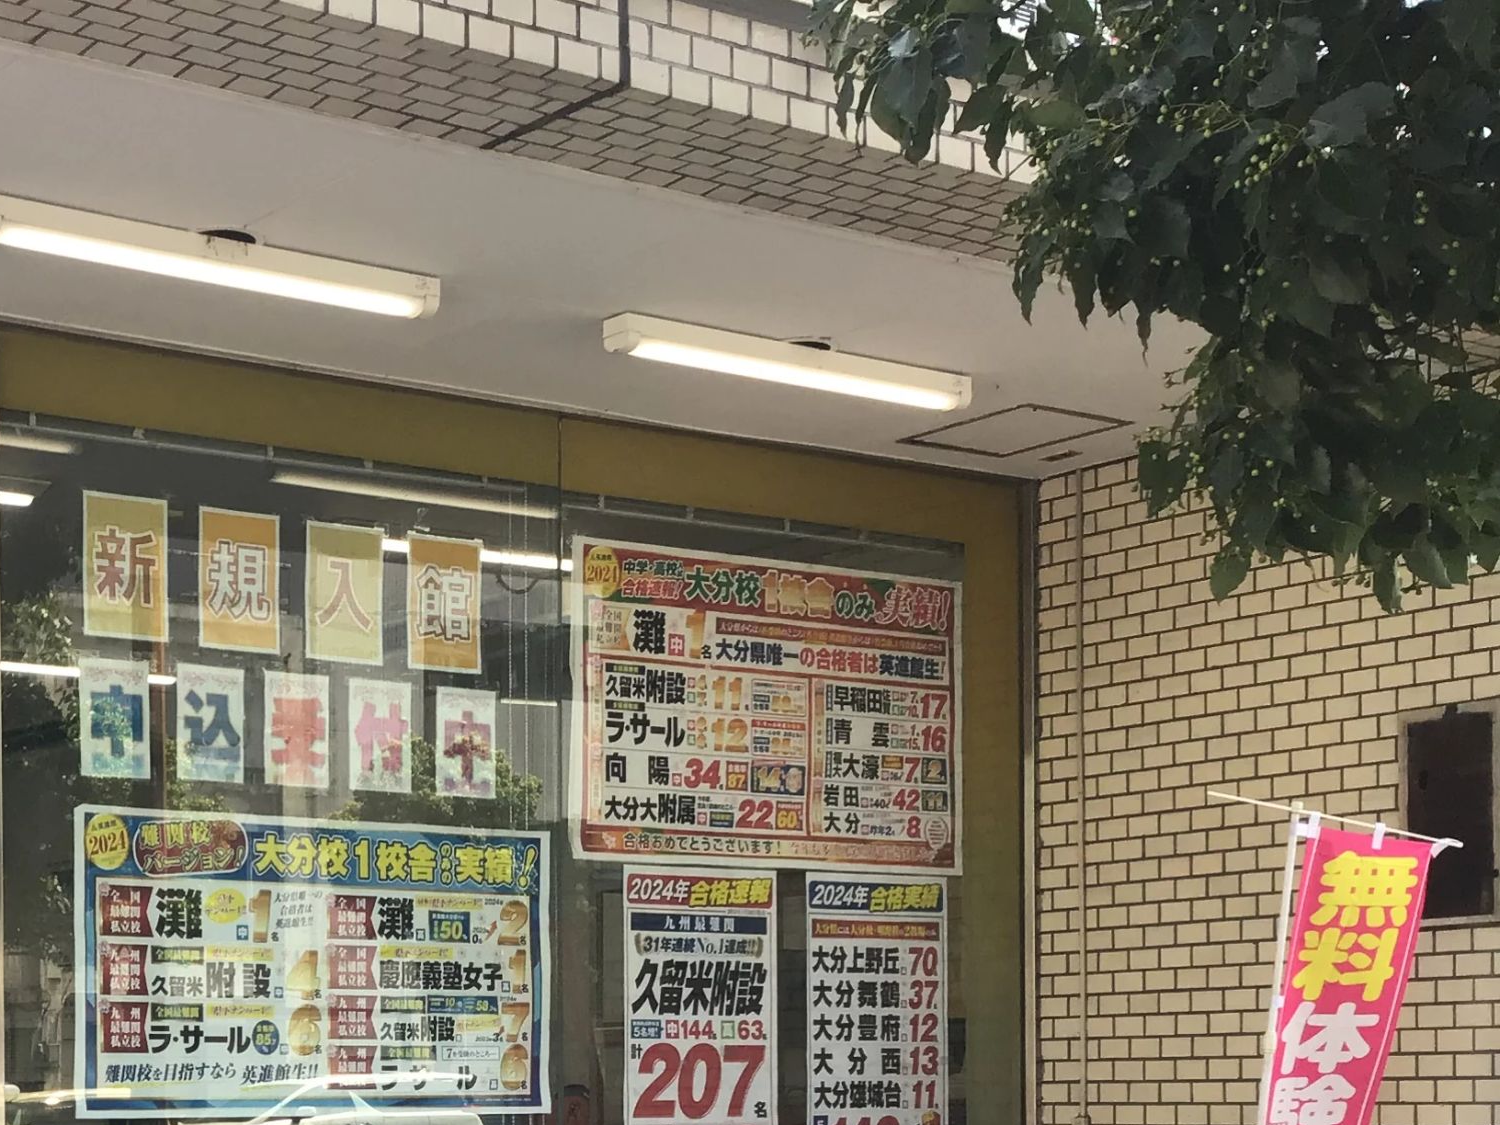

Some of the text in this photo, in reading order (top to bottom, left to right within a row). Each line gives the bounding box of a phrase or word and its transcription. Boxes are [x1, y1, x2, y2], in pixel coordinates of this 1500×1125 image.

[94, 524, 472, 643] 新規入館
[606, 712, 685, 747] ラ・サール
[89, 830, 126, 856] 2024
[812, 945, 900, 974] 大分上野丘
[151, 961, 272, 999] 久留米附設
[631, 958, 768, 1016] 久留米附設
[149, 1025, 251, 1054] ラ・サール
[105, 1061, 237, 1084] 難関校を目指すなら
[813, 1047, 901, 1075] 大分西
